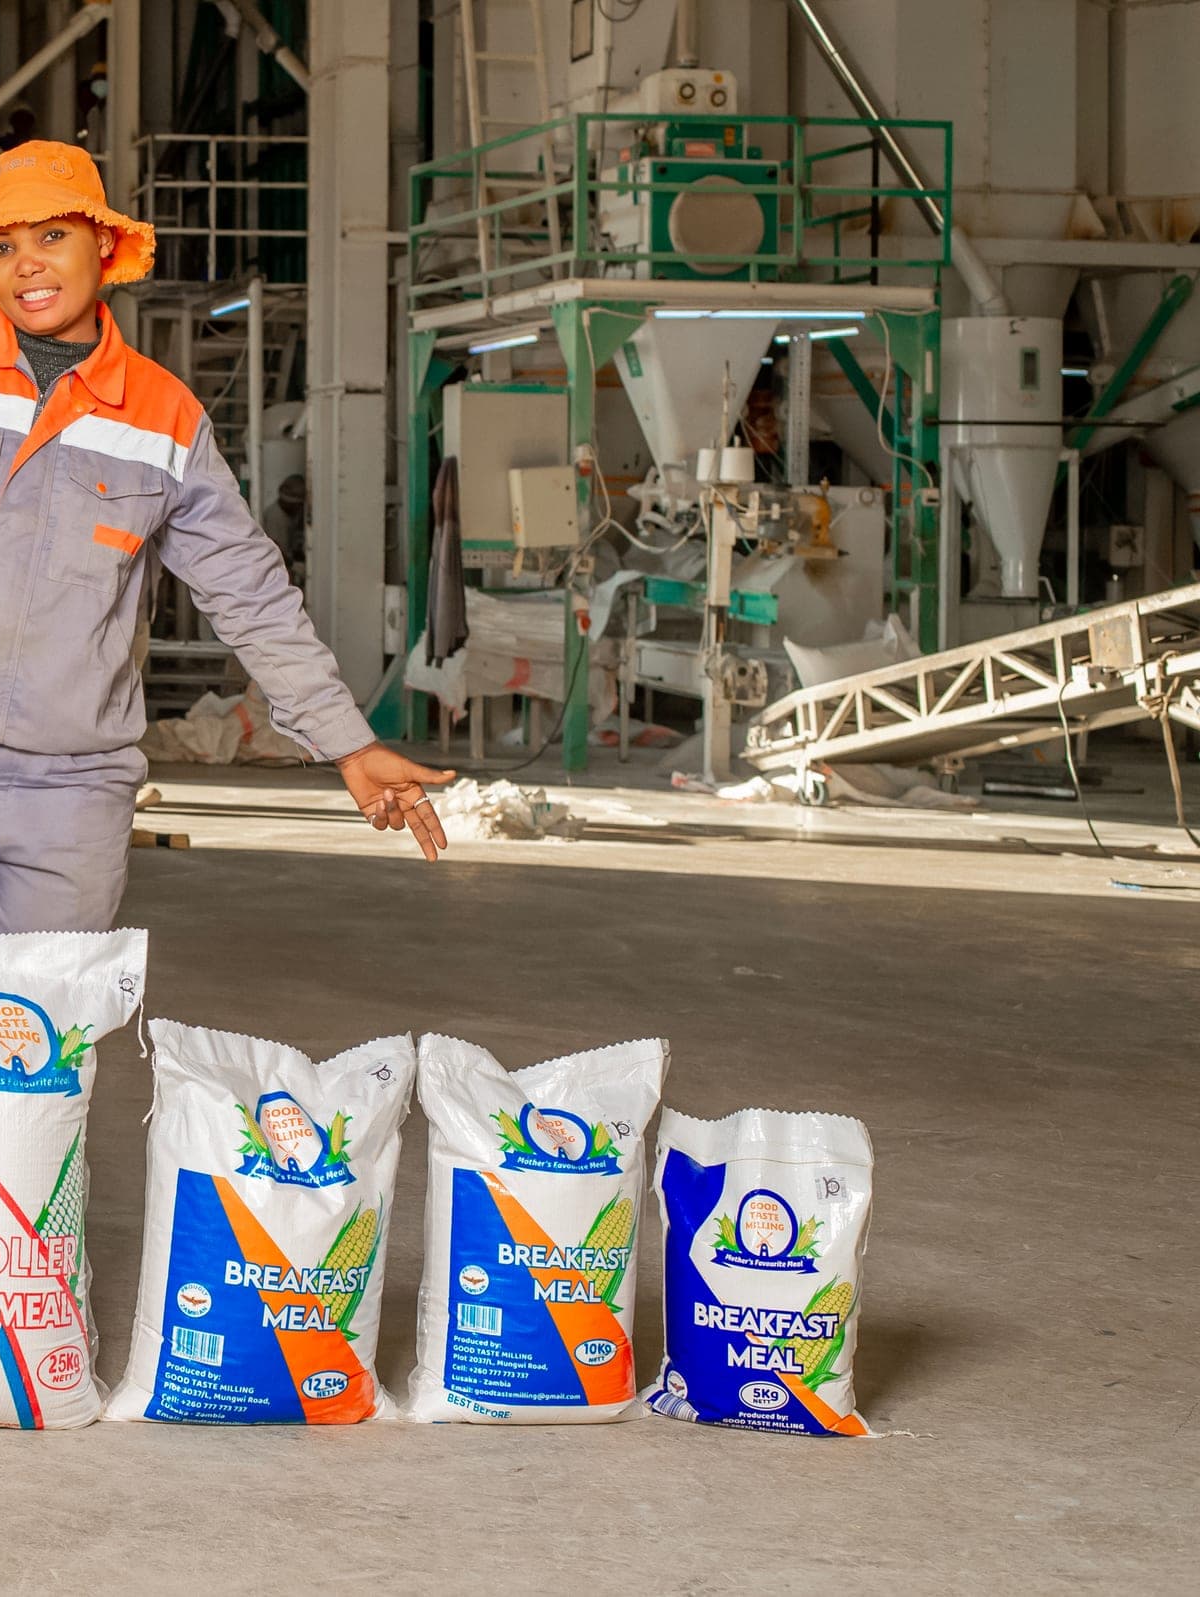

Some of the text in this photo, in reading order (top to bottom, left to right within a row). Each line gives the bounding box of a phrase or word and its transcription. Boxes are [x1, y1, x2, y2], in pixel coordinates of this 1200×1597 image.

[517, 1157, 551, 1168] Mother's
[590, 1160, 606, 1168] Meal
[326, 1168, 345, 1180] Meal
[750, 1202, 778, 1212] GOOD
[750, 1212, 779, 1221] TASTE
[498, 1243, 629, 1270] BREAKFAST
[224, 1260, 369, 1293] BREAKFAST
[534, 1278, 602, 1303] MEAL
[262, 1302, 336, 1331] MEAL
[693, 1301, 838, 1339] BREAKFAST
[454, 1336, 501, 1349] Produced by:
[583, 1343, 612, 1355] 10Kg
[453, 1345, 475, 1354] GOOD
[502, 1352, 532, 1360] MILLING
[727, 1343, 803, 1374] MEAL
[49, 1353, 81, 1376] 25Kg
[166, 1361, 221, 1380] Produced by:
[452, 1364, 467, 1372] Cell:
[497, 1360, 526, 1369] Mungwi
[52, 1372, 74, 1383] NETT
[165, 1372, 254, 1393] GOOD TASTE MILLING
[452, 1374, 511, 1388] Lusaka Zambia
[214, 1393, 246, 1402] Mungwi
[451, 1384, 581, 1401] Email: goodtastemilling@gmail.com
[753, 1388, 779, 1401] 5Kg
[162, 1394, 179, 1403] Cell:
[181, 1399, 201, 1408] +260
[447, 1394, 471, 1408] BEST
[738, 1412, 775, 1420] Produced
[772, 1422, 805, 1430] MILLING
